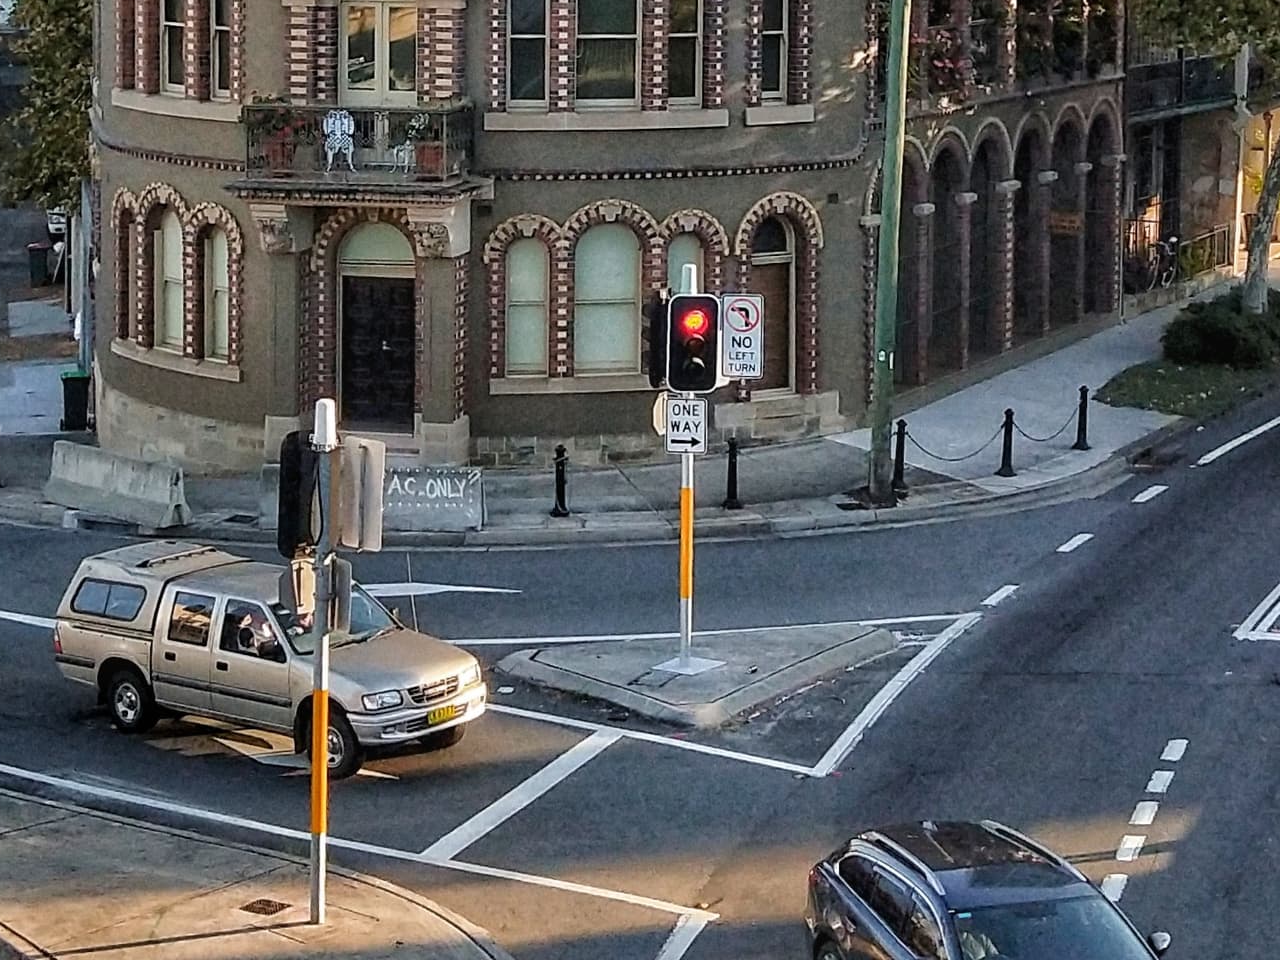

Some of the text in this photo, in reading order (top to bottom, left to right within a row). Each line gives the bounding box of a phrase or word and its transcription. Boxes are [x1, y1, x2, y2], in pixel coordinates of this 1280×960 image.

[731, 336, 752, 349] NO
[728, 351, 754, 361] LEFT
[728, 363, 756, 373] TURN
[672, 404, 700, 417] ONE
[670, 421, 701, 433] WAY
[426, 478, 466, 499] ONLY
